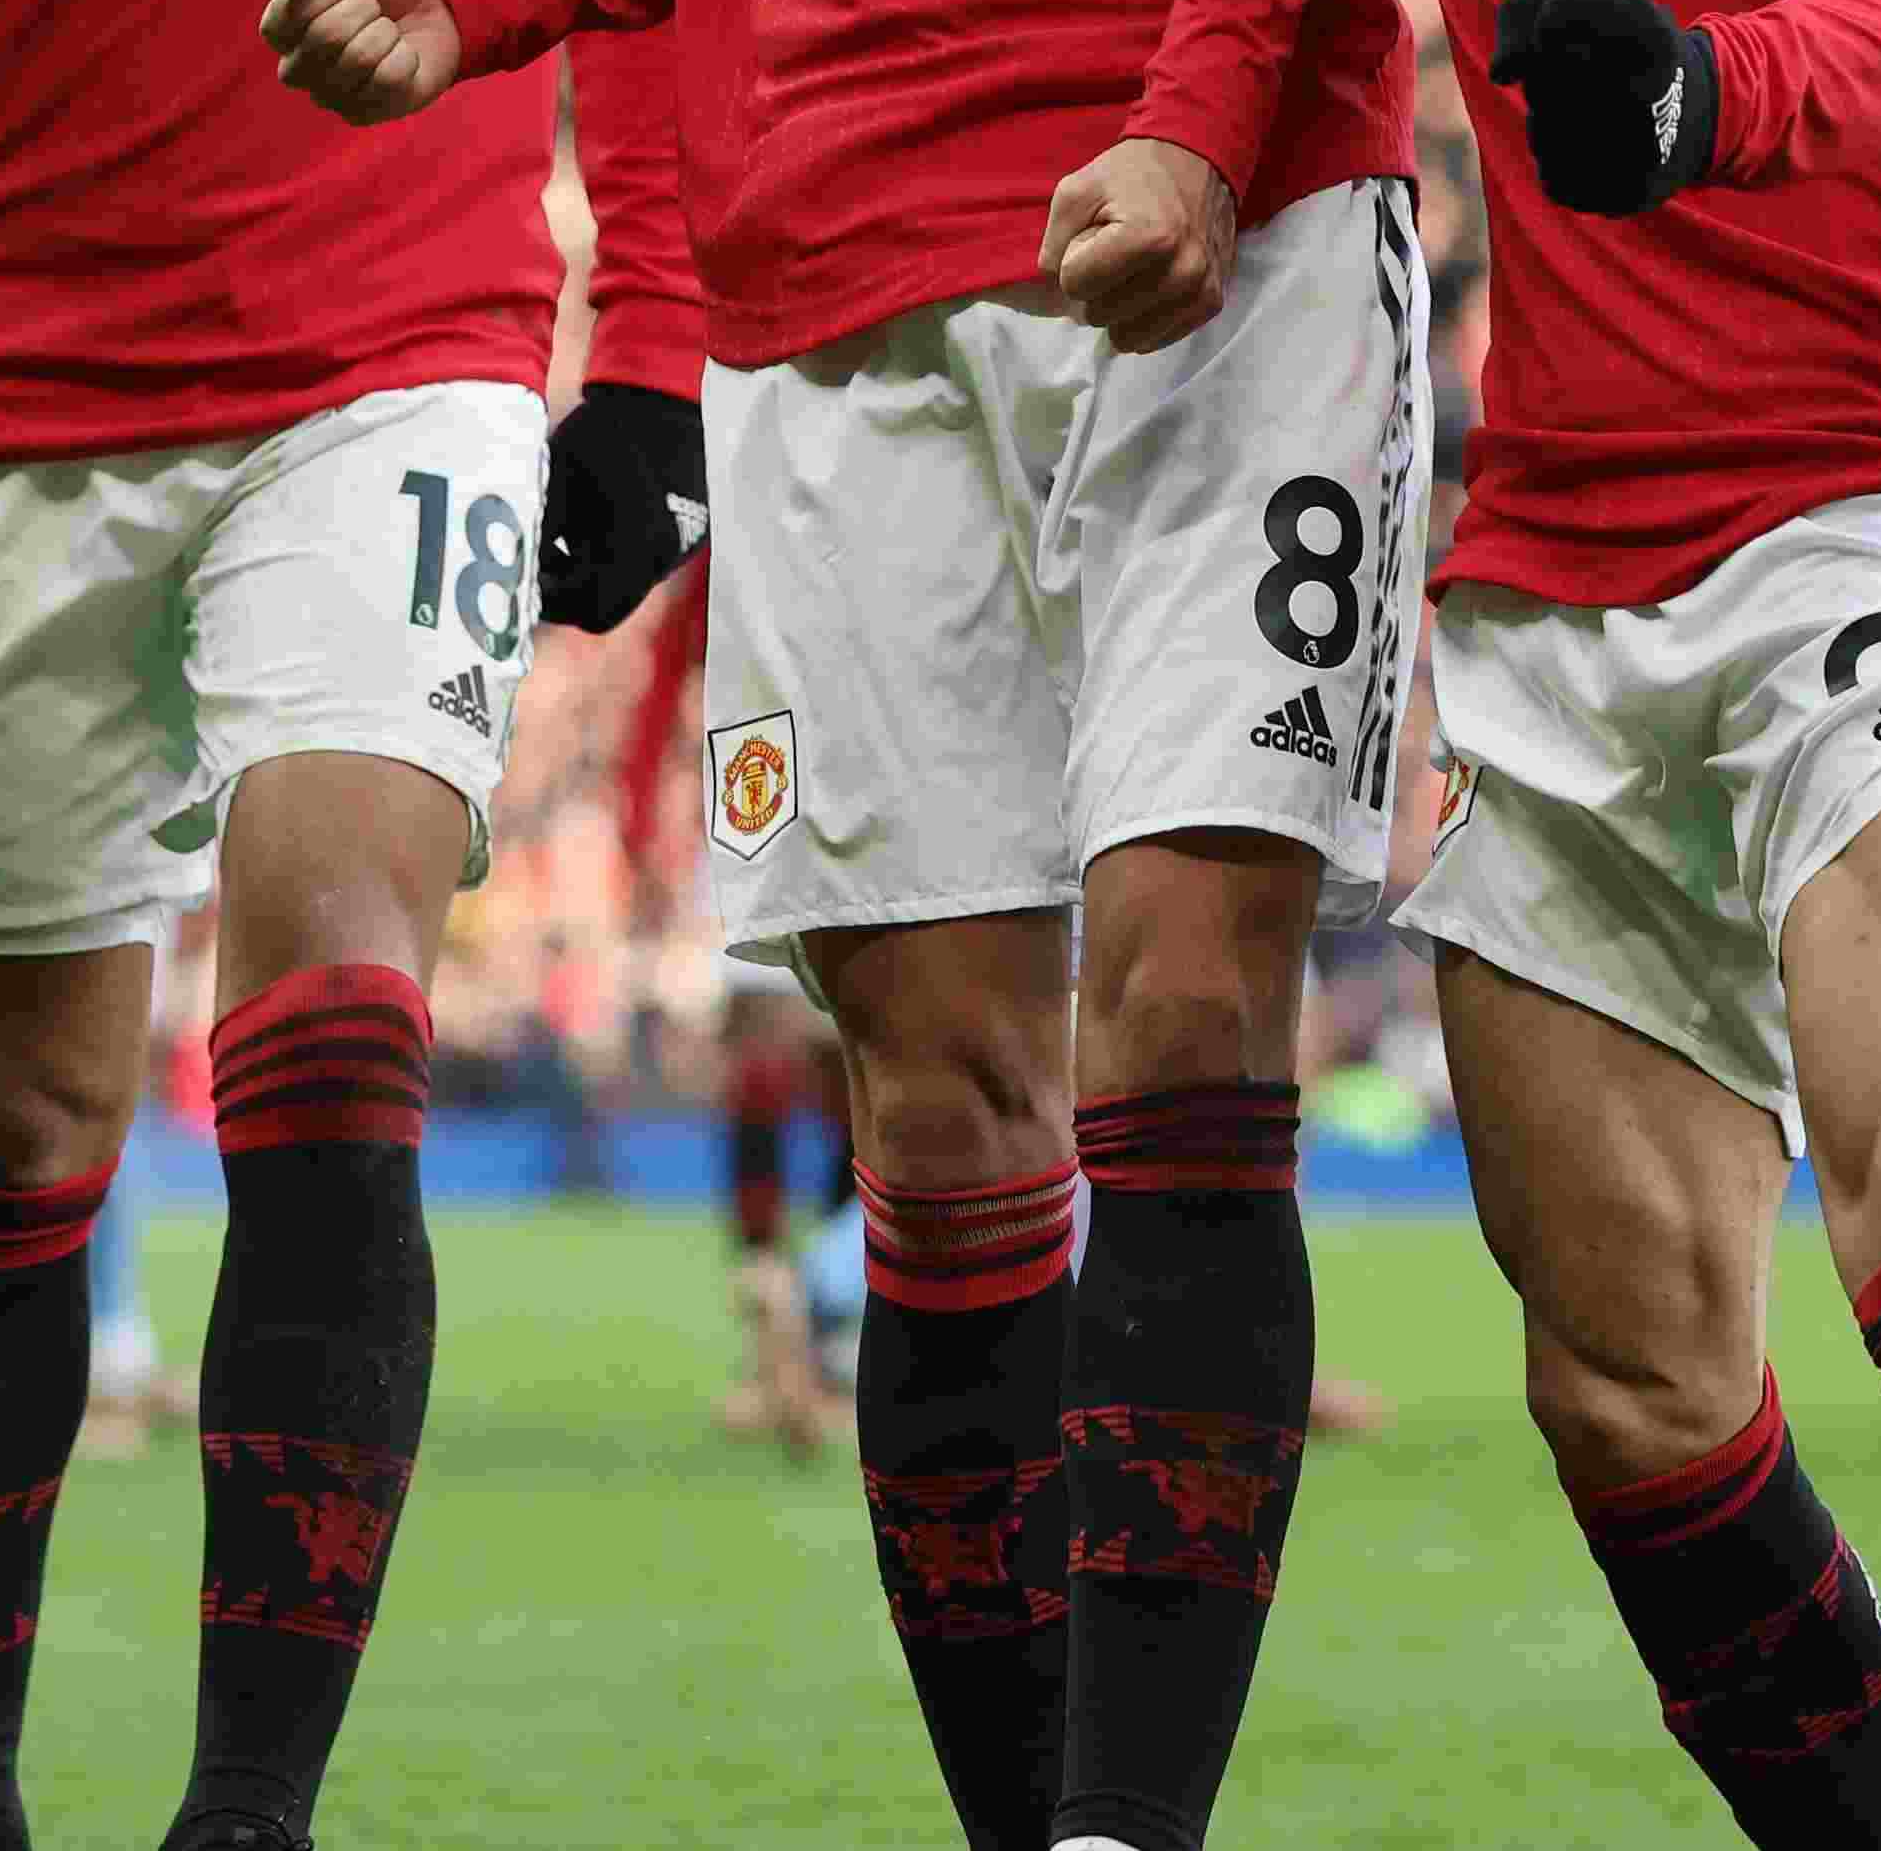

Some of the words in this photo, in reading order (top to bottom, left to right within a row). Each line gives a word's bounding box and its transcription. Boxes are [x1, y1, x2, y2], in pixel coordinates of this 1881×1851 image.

[398, 469, 524, 662] 18
[1254, 475, 1364, 670] 8
[1249, 722, 1338, 768] adidas
